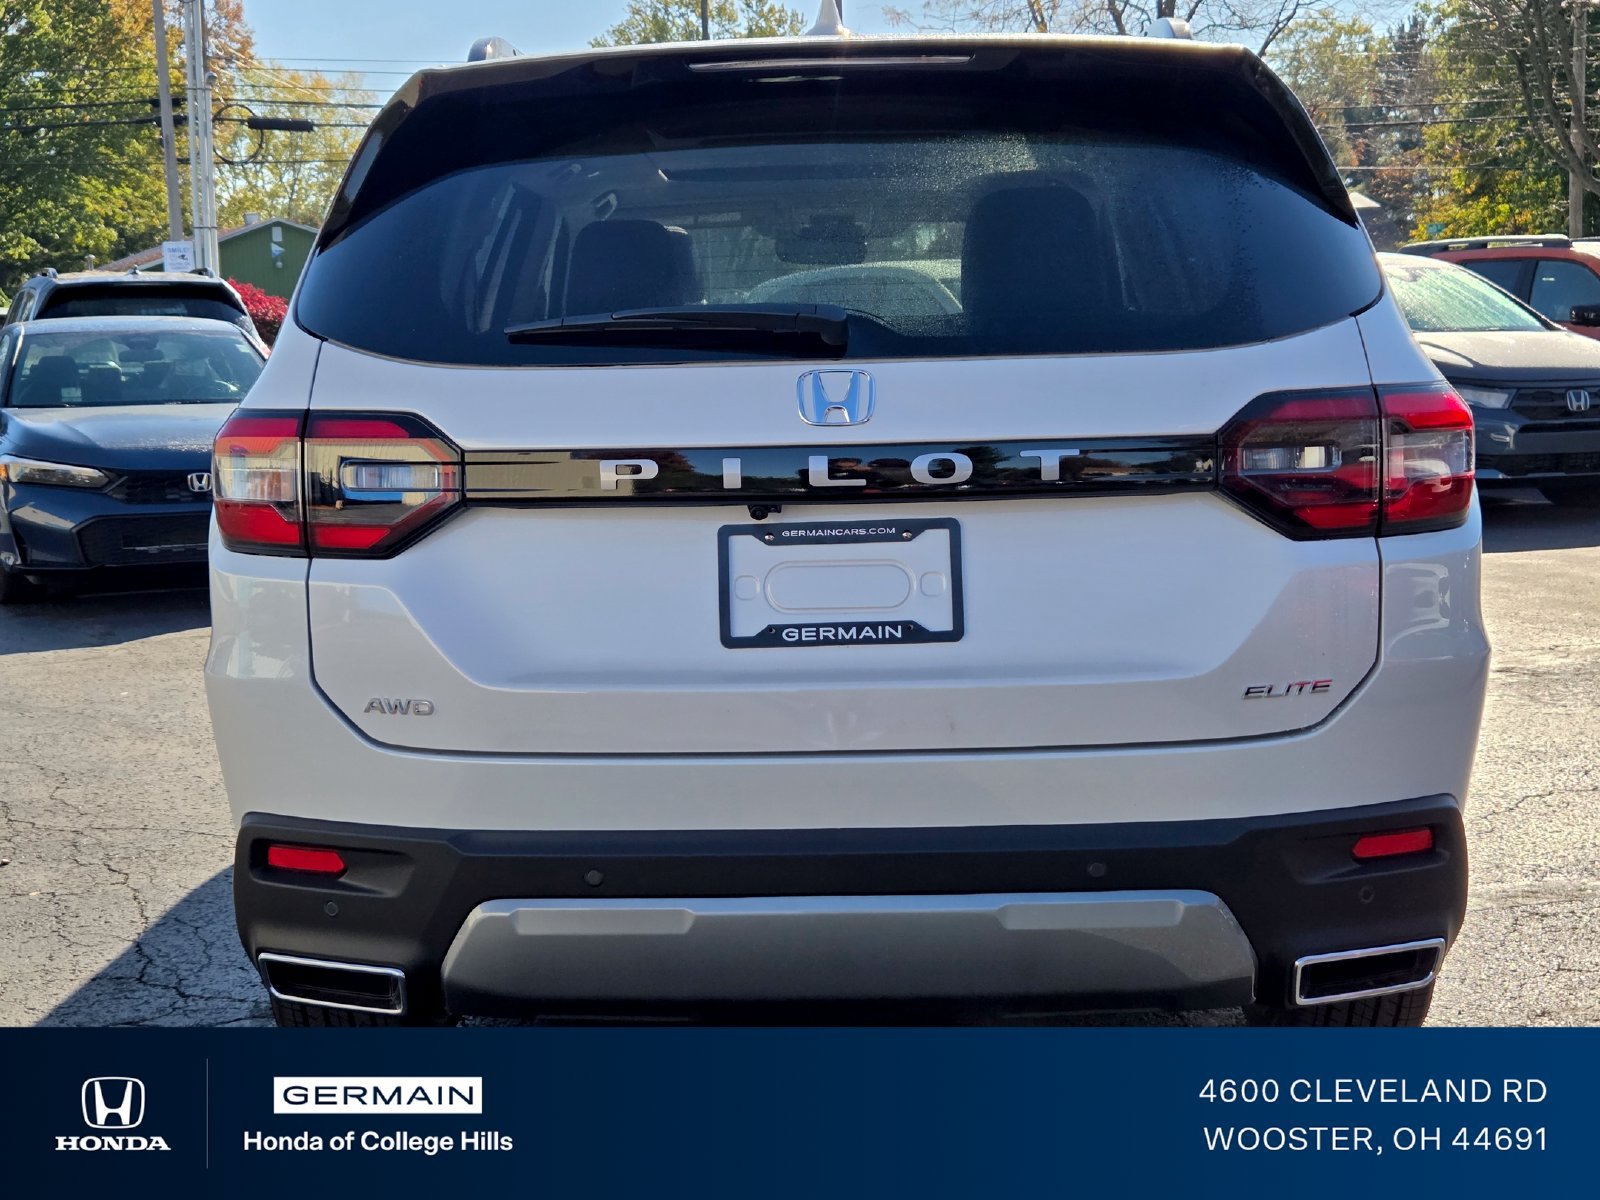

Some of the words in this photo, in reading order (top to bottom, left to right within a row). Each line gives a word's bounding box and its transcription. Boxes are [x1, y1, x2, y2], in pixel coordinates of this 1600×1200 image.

[600, 448, 1080, 490] PILOT
[782, 527, 896, 537] GERMAINCARS.COM
[782, 624, 902, 641] GERMAIN
[1243, 679, 1333, 699] ELITE
[363, 697, 435, 716] AWD
